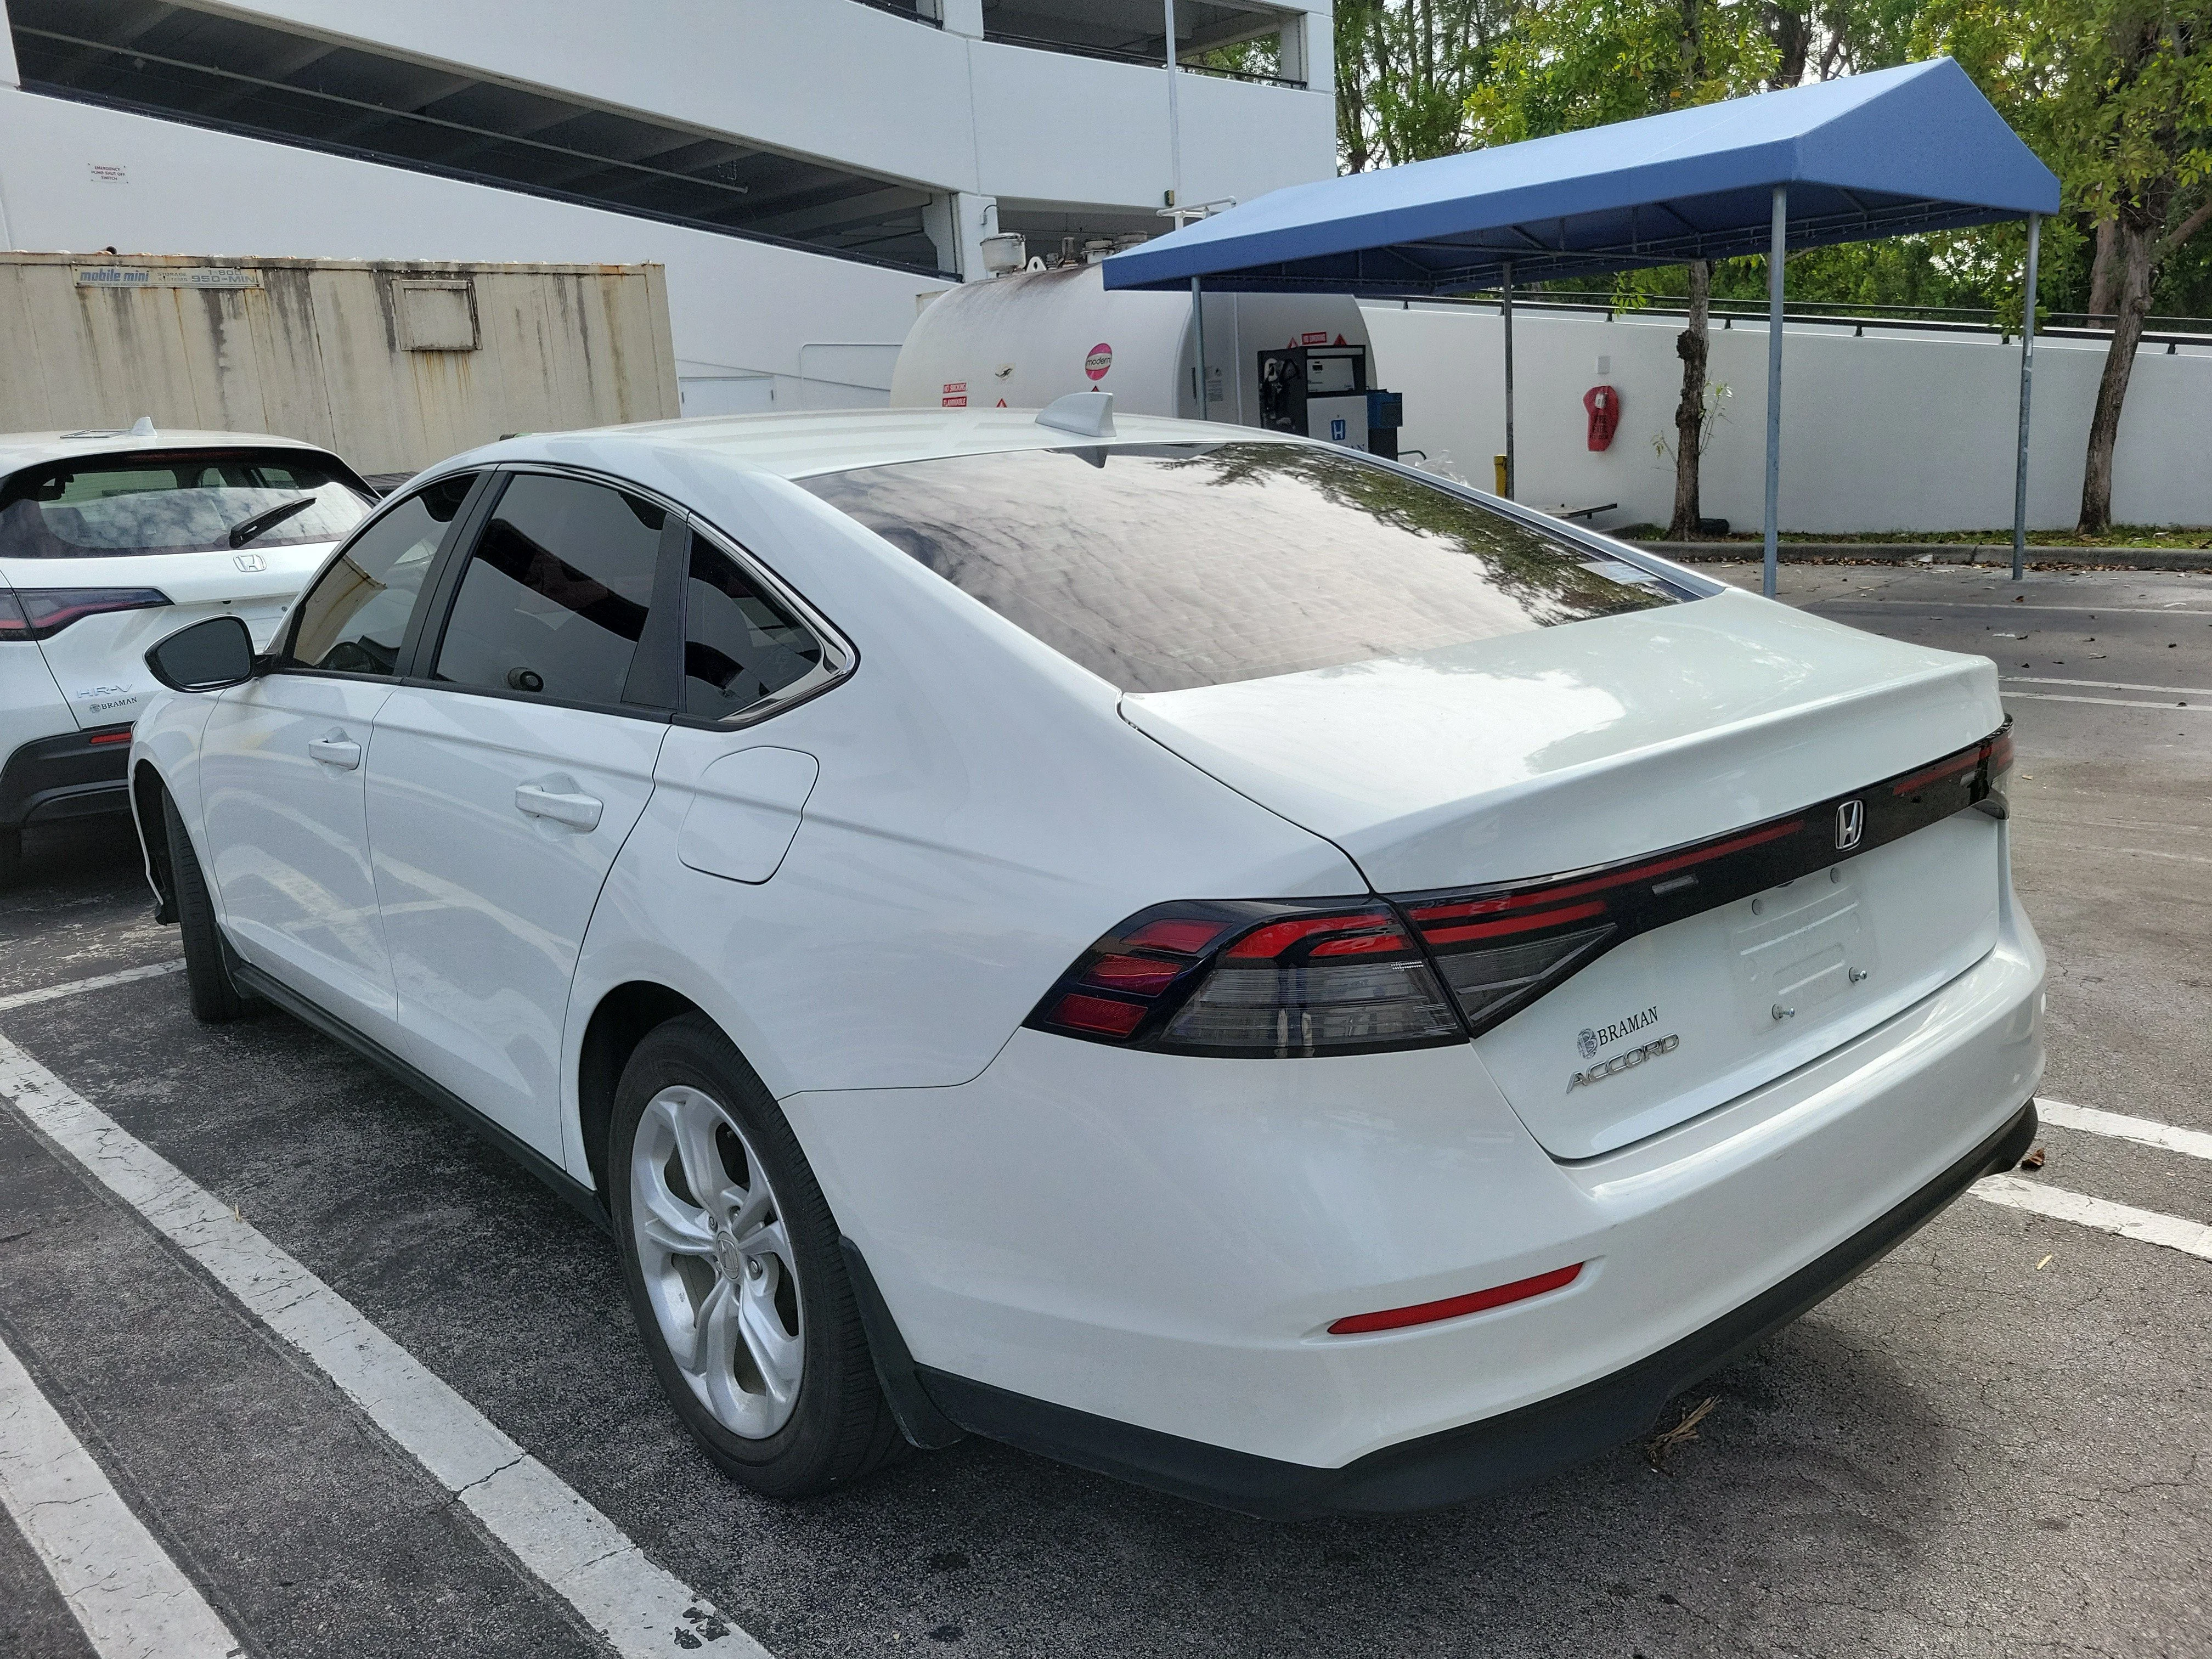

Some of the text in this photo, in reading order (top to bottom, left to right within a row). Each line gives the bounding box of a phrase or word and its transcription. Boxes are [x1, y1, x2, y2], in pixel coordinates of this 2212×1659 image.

[80, 268, 149, 281] mobile mini
[1086, 357, 1111, 366] modern
[77, 683, 133, 698] HR-V
[101, 697, 138, 709] BRAMAN
[1597, 1006, 1658, 1046] BRAMAN
[1566, 1032, 1679, 1094] ACCORD
